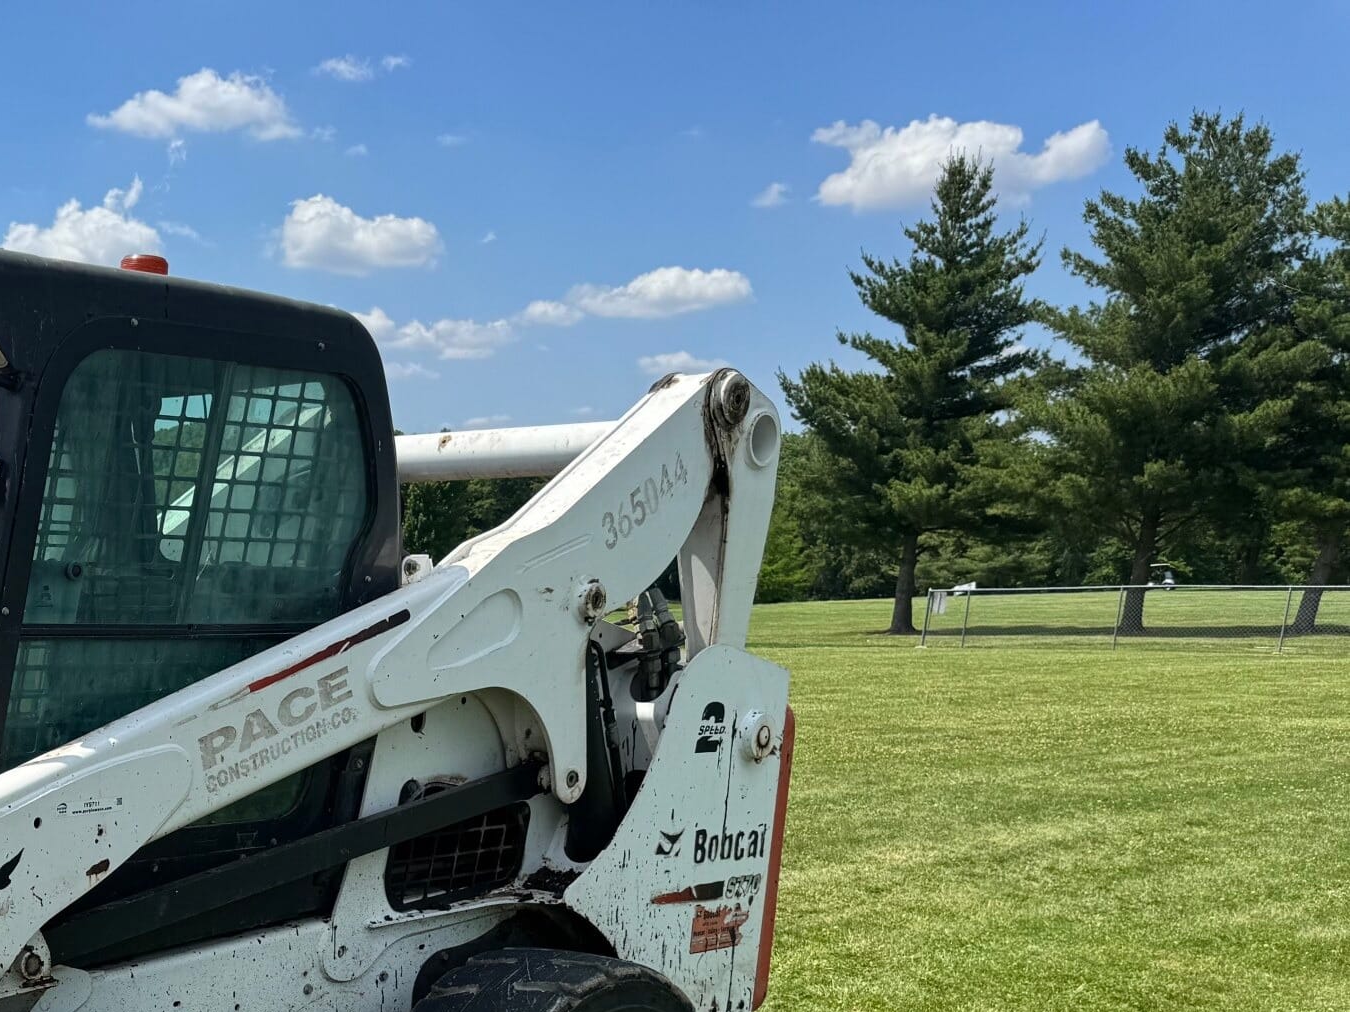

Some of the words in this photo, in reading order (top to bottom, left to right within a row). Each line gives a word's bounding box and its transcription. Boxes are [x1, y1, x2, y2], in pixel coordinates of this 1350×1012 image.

[198, 665, 353, 771] PACE
[695, 701, 725, 753] 2
[205, 718, 327, 793] CONSTRUCTION
[693, 824, 767, 863] Bobcat
